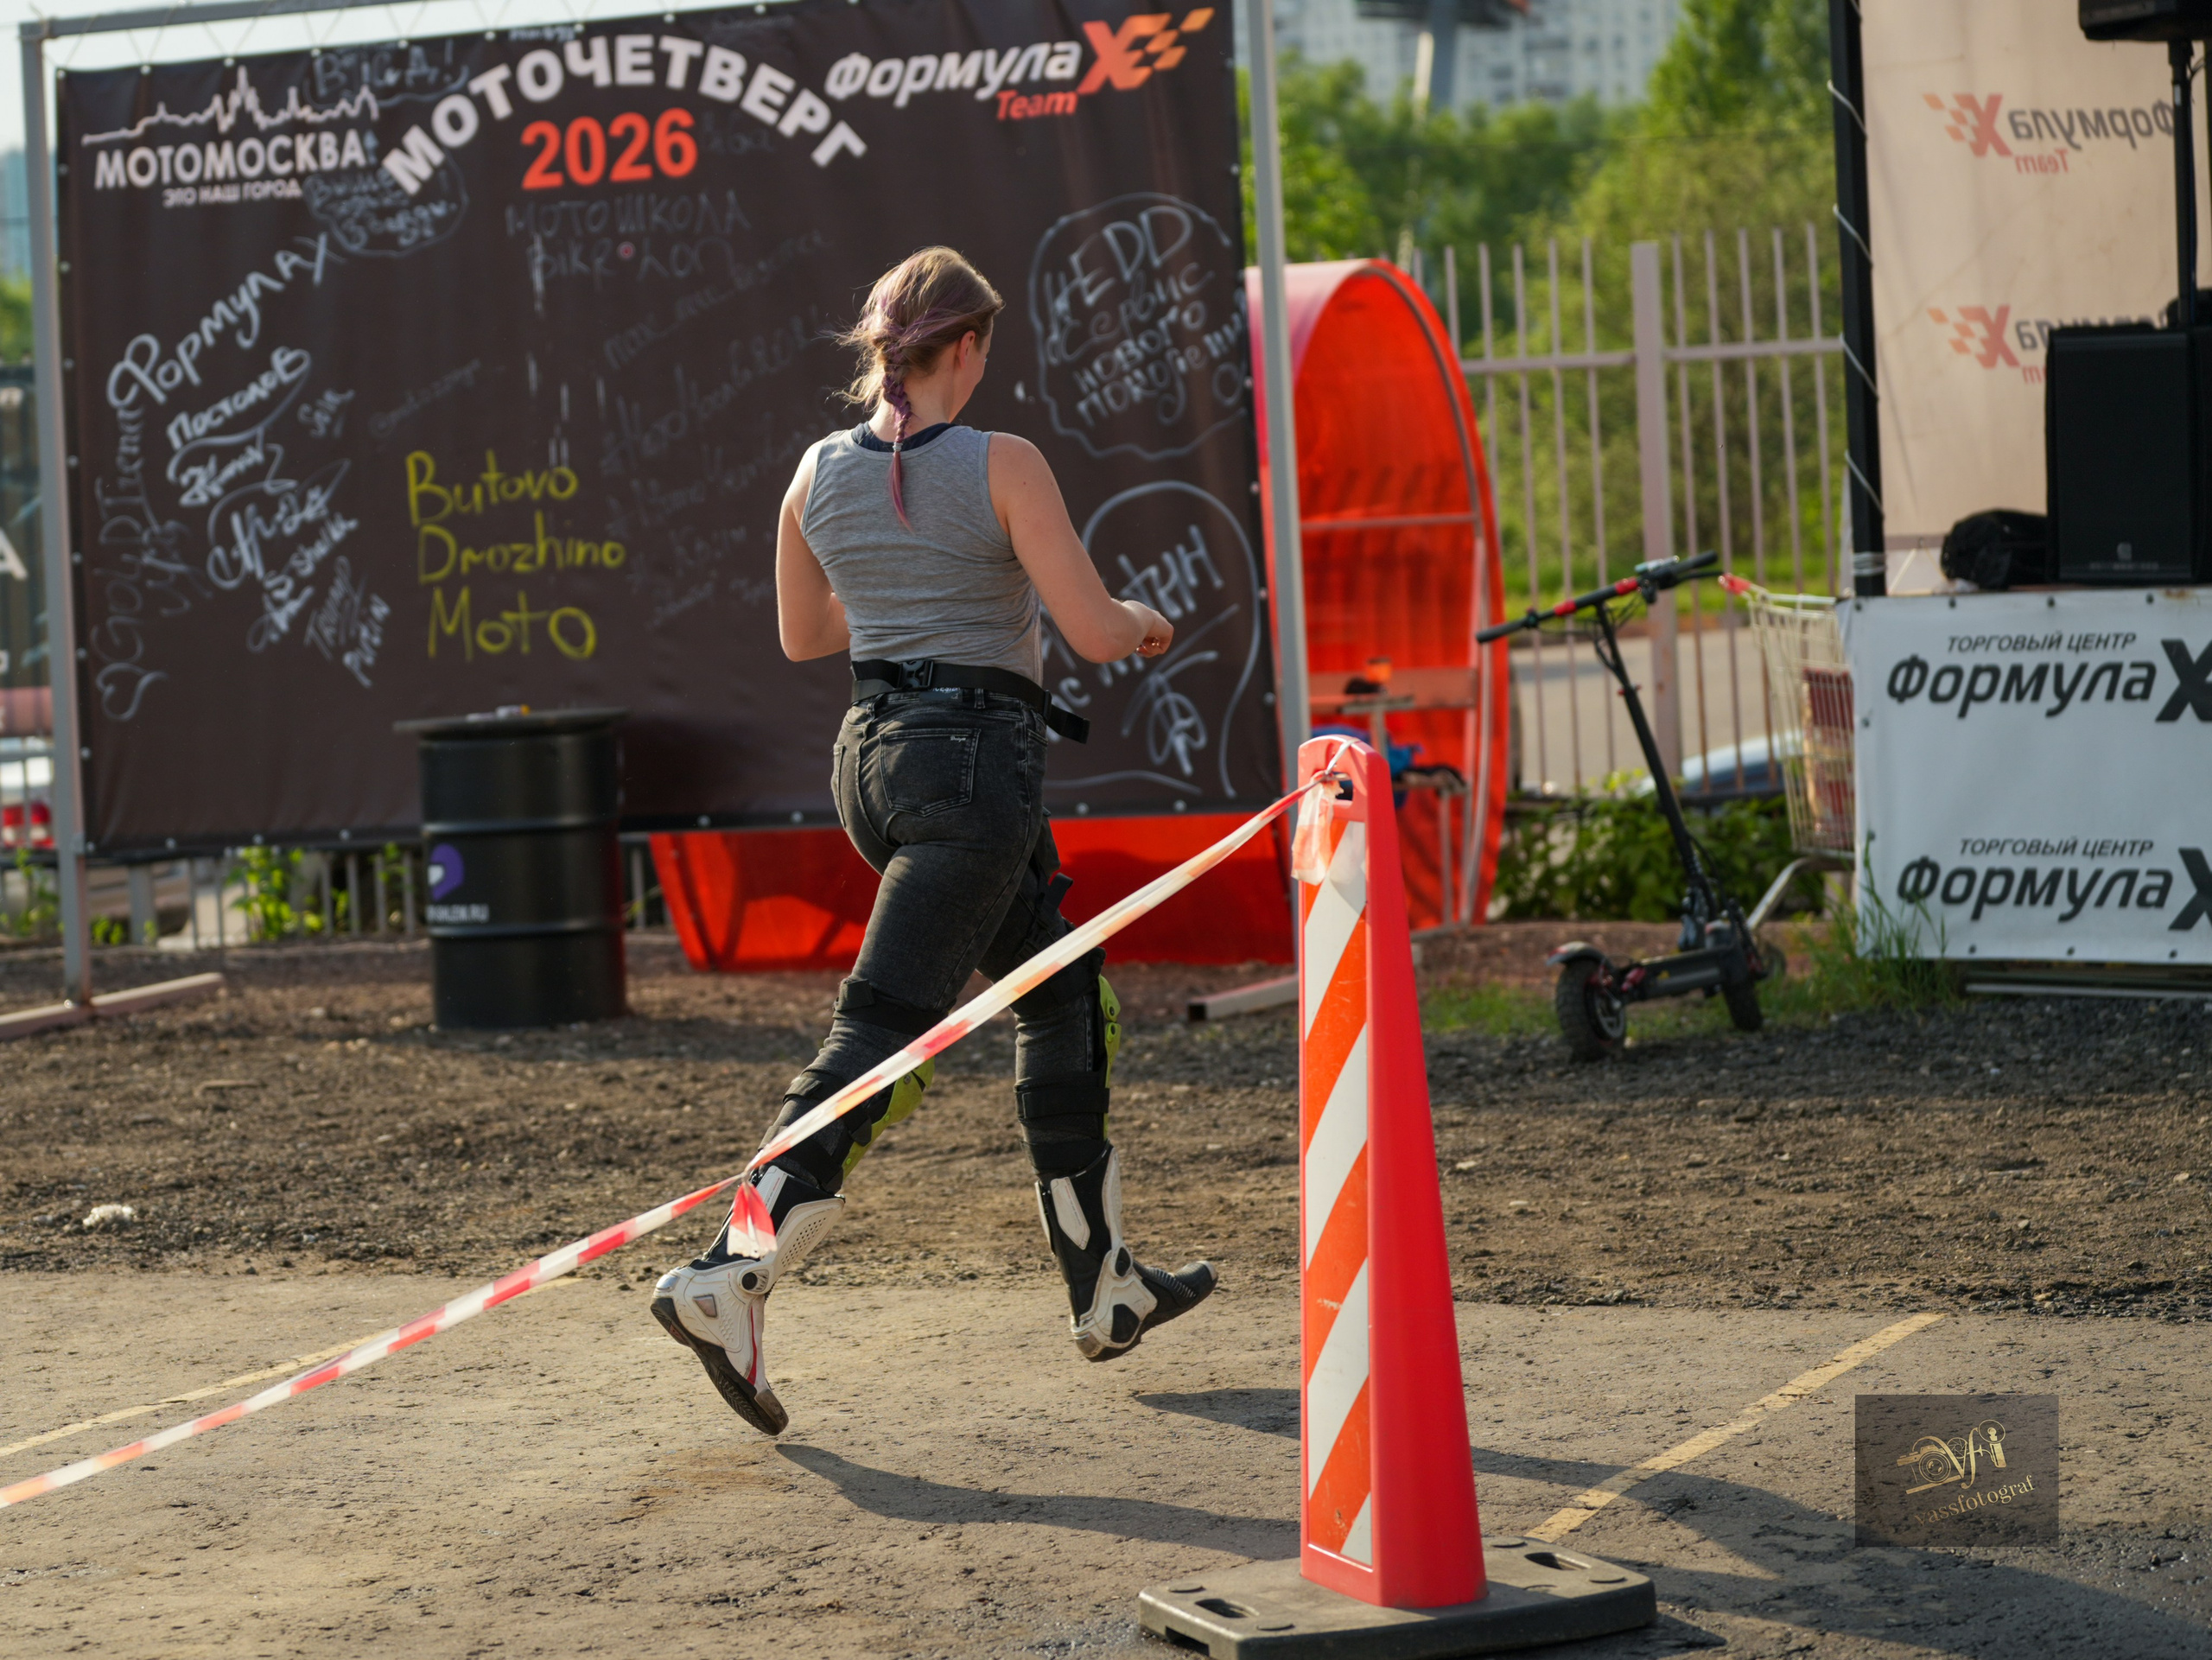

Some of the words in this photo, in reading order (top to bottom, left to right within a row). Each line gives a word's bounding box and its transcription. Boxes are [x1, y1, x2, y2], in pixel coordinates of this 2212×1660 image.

[382, 35, 868, 195] МОТОЧЕТВЕРГ
[995, 90, 1079, 121] Team
[94, 129, 365, 189] МОТОМОСКВА
[521, 107, 697, 190] 2026
[162, 187, 197, 208] ЭТО
[199, 184, 240, 205] НАШ
[242, 178, 302, 201] ГОРОД
[406, 449, 579, 527] Butovo
[418, 511, 625, 585] Drozhino
[1948, 630, 2063, 653] ТОРГОВЫЙ
[2068, 633, 2137, 653] ЦЕНТР
[1959, 835, 2078, 857] ТОРГОВЫЙ
[2082, 839, 2154, 861] ЦЕНТР
